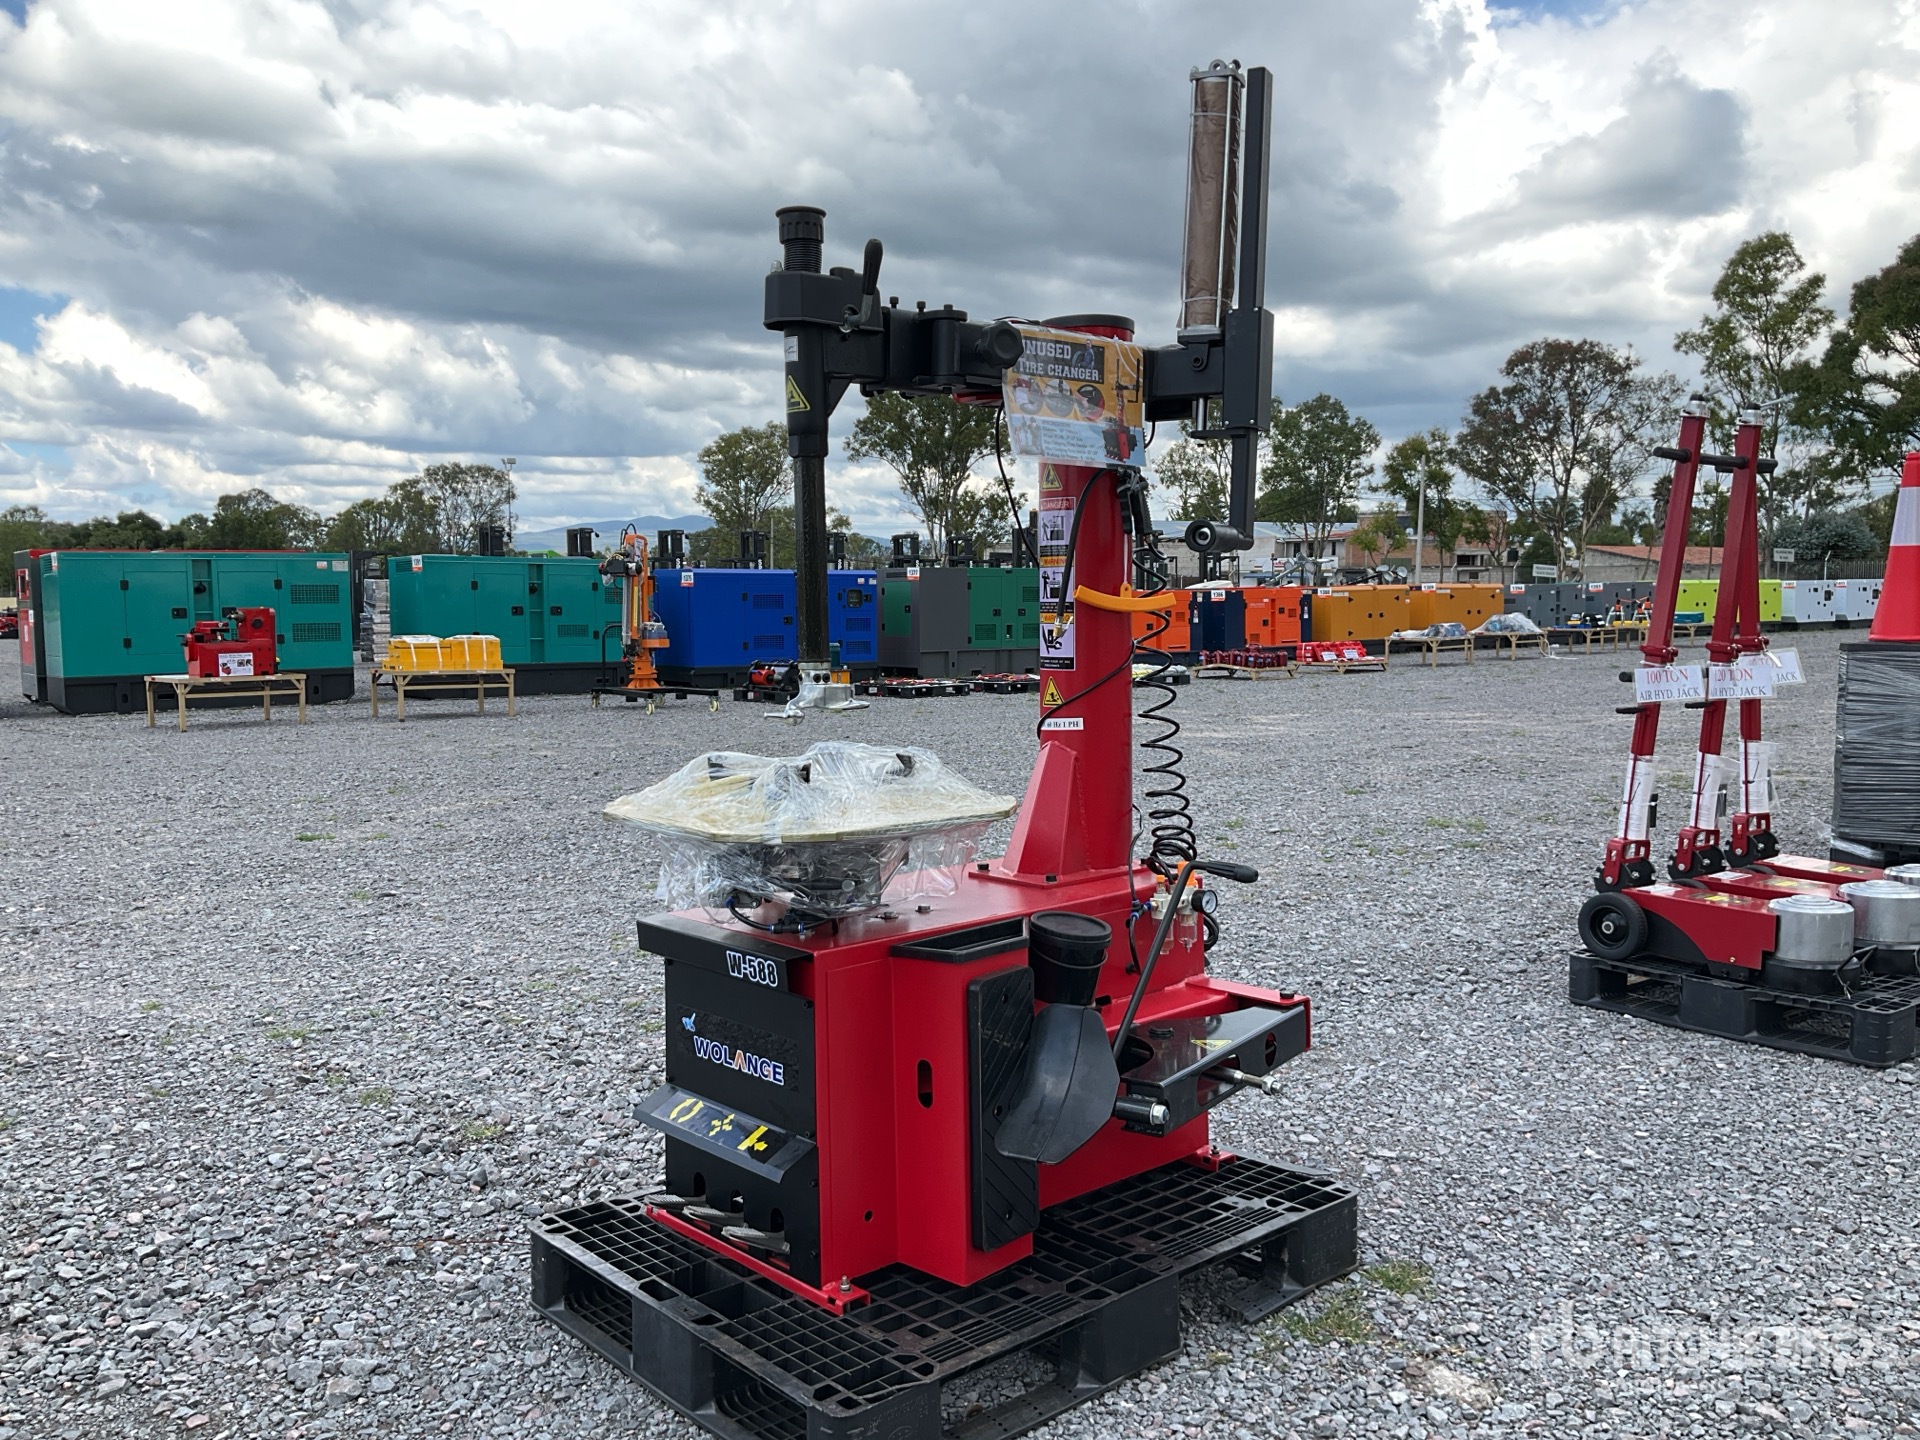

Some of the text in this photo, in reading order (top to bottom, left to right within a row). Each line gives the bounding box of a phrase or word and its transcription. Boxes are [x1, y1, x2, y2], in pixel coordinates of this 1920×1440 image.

[1019, 358, 1099, 381] TIRE CHANGER
[1044, 501, 1070, 511] DANGER
[1044, 558, 1067, 566] WARNIN
[1646, 668, 1689, 684] 100 TON
[1777, 671, 1798, 682] JACK
[1640, 686, 1701, 701] AIR HYD. JACK
[1740, 686, 1767, 697] JACK
[726, 950, 778, 987] W-588
[693, 1034, 785, 1086] WOLANGE
